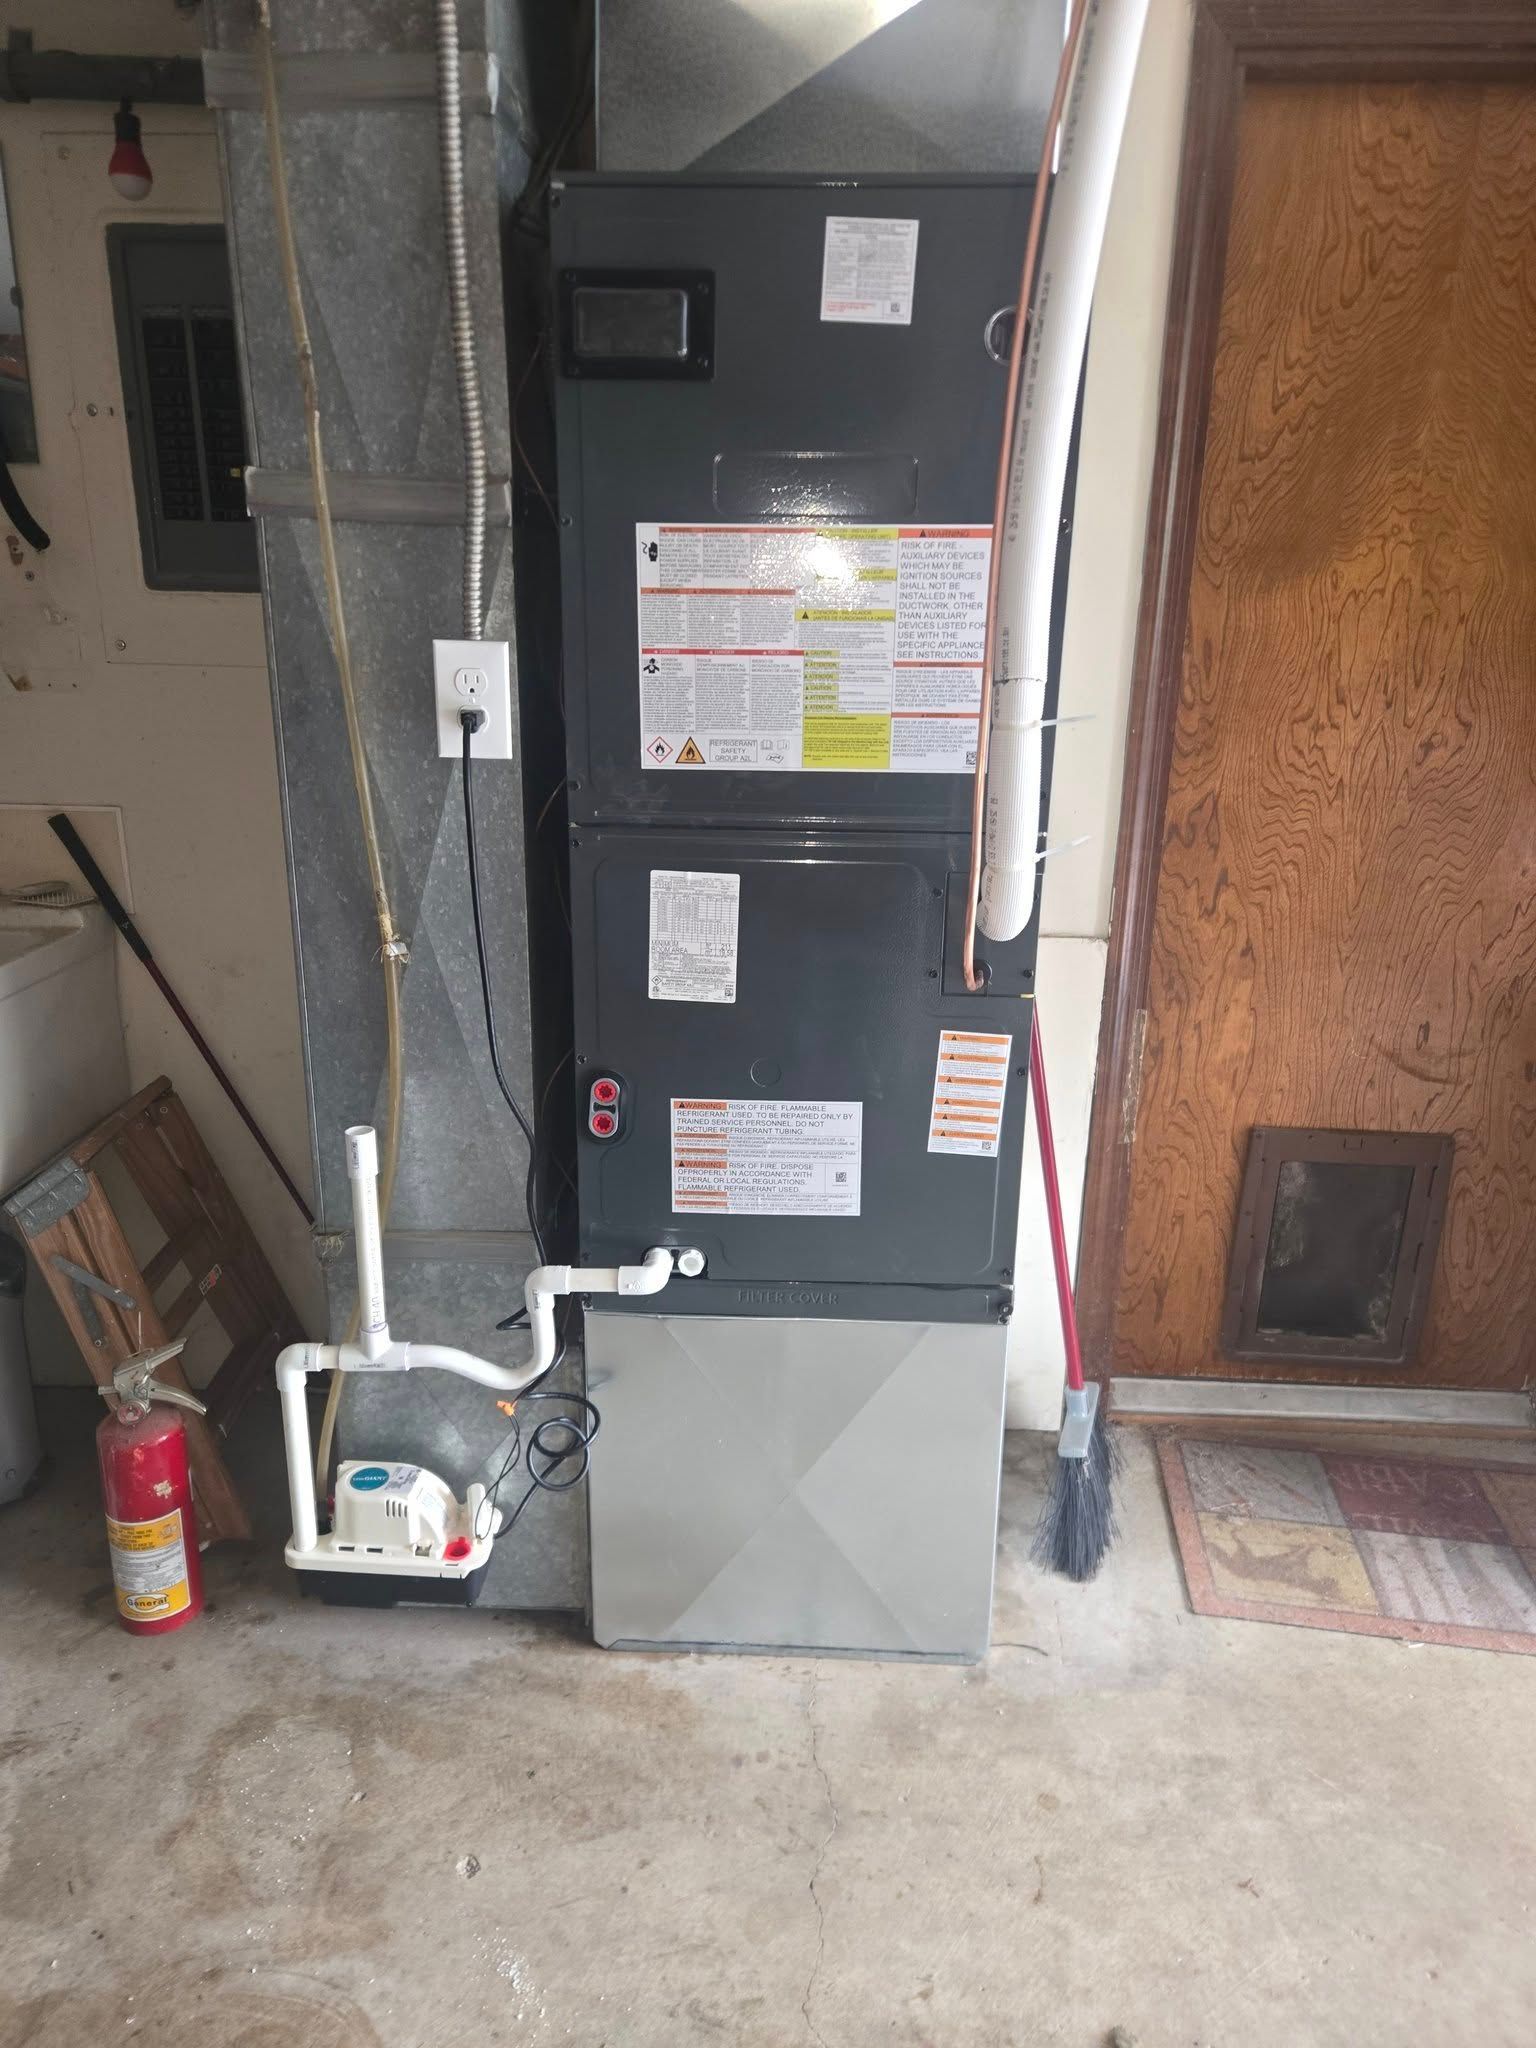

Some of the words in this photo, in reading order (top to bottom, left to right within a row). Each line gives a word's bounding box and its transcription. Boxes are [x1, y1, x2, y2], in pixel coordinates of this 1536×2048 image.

[928, 529, 969, 538] WARNING
[738, 1288, 784, 1303] FILTER
[789, 1292, 839, 1304] COVER
[127, 1596, 167, 1607] General
